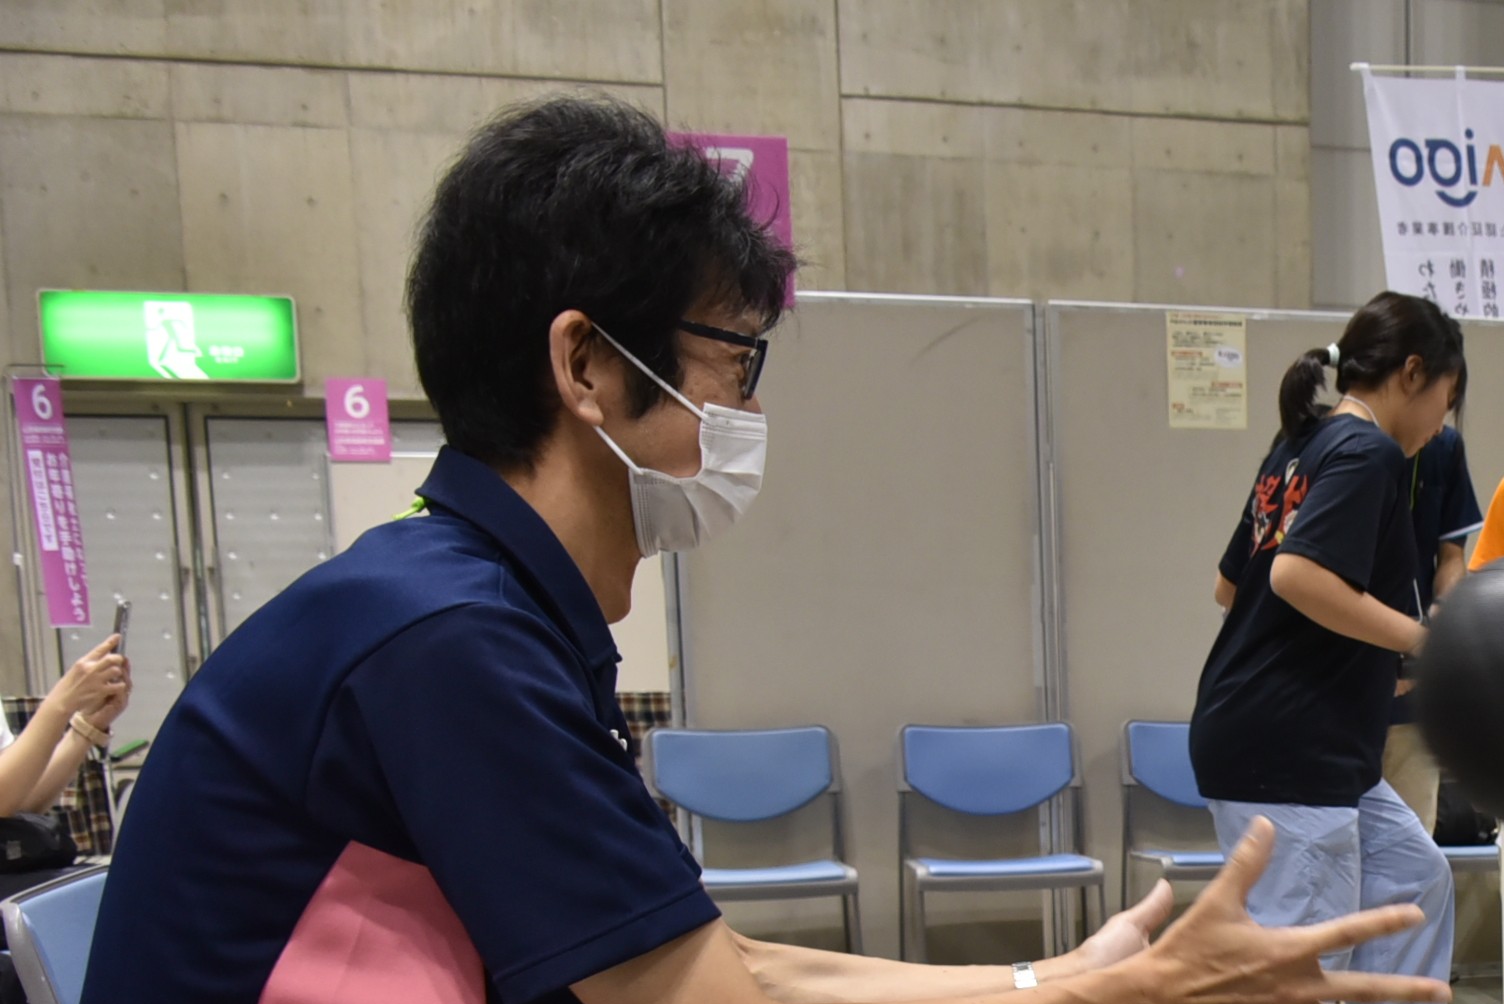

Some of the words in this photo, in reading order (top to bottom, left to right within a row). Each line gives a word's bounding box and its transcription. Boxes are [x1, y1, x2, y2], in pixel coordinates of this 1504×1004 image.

[704, 146, 754, 197] 7
[32, 384, 53, 420] 6
[344, 384, 370, 419] 6
